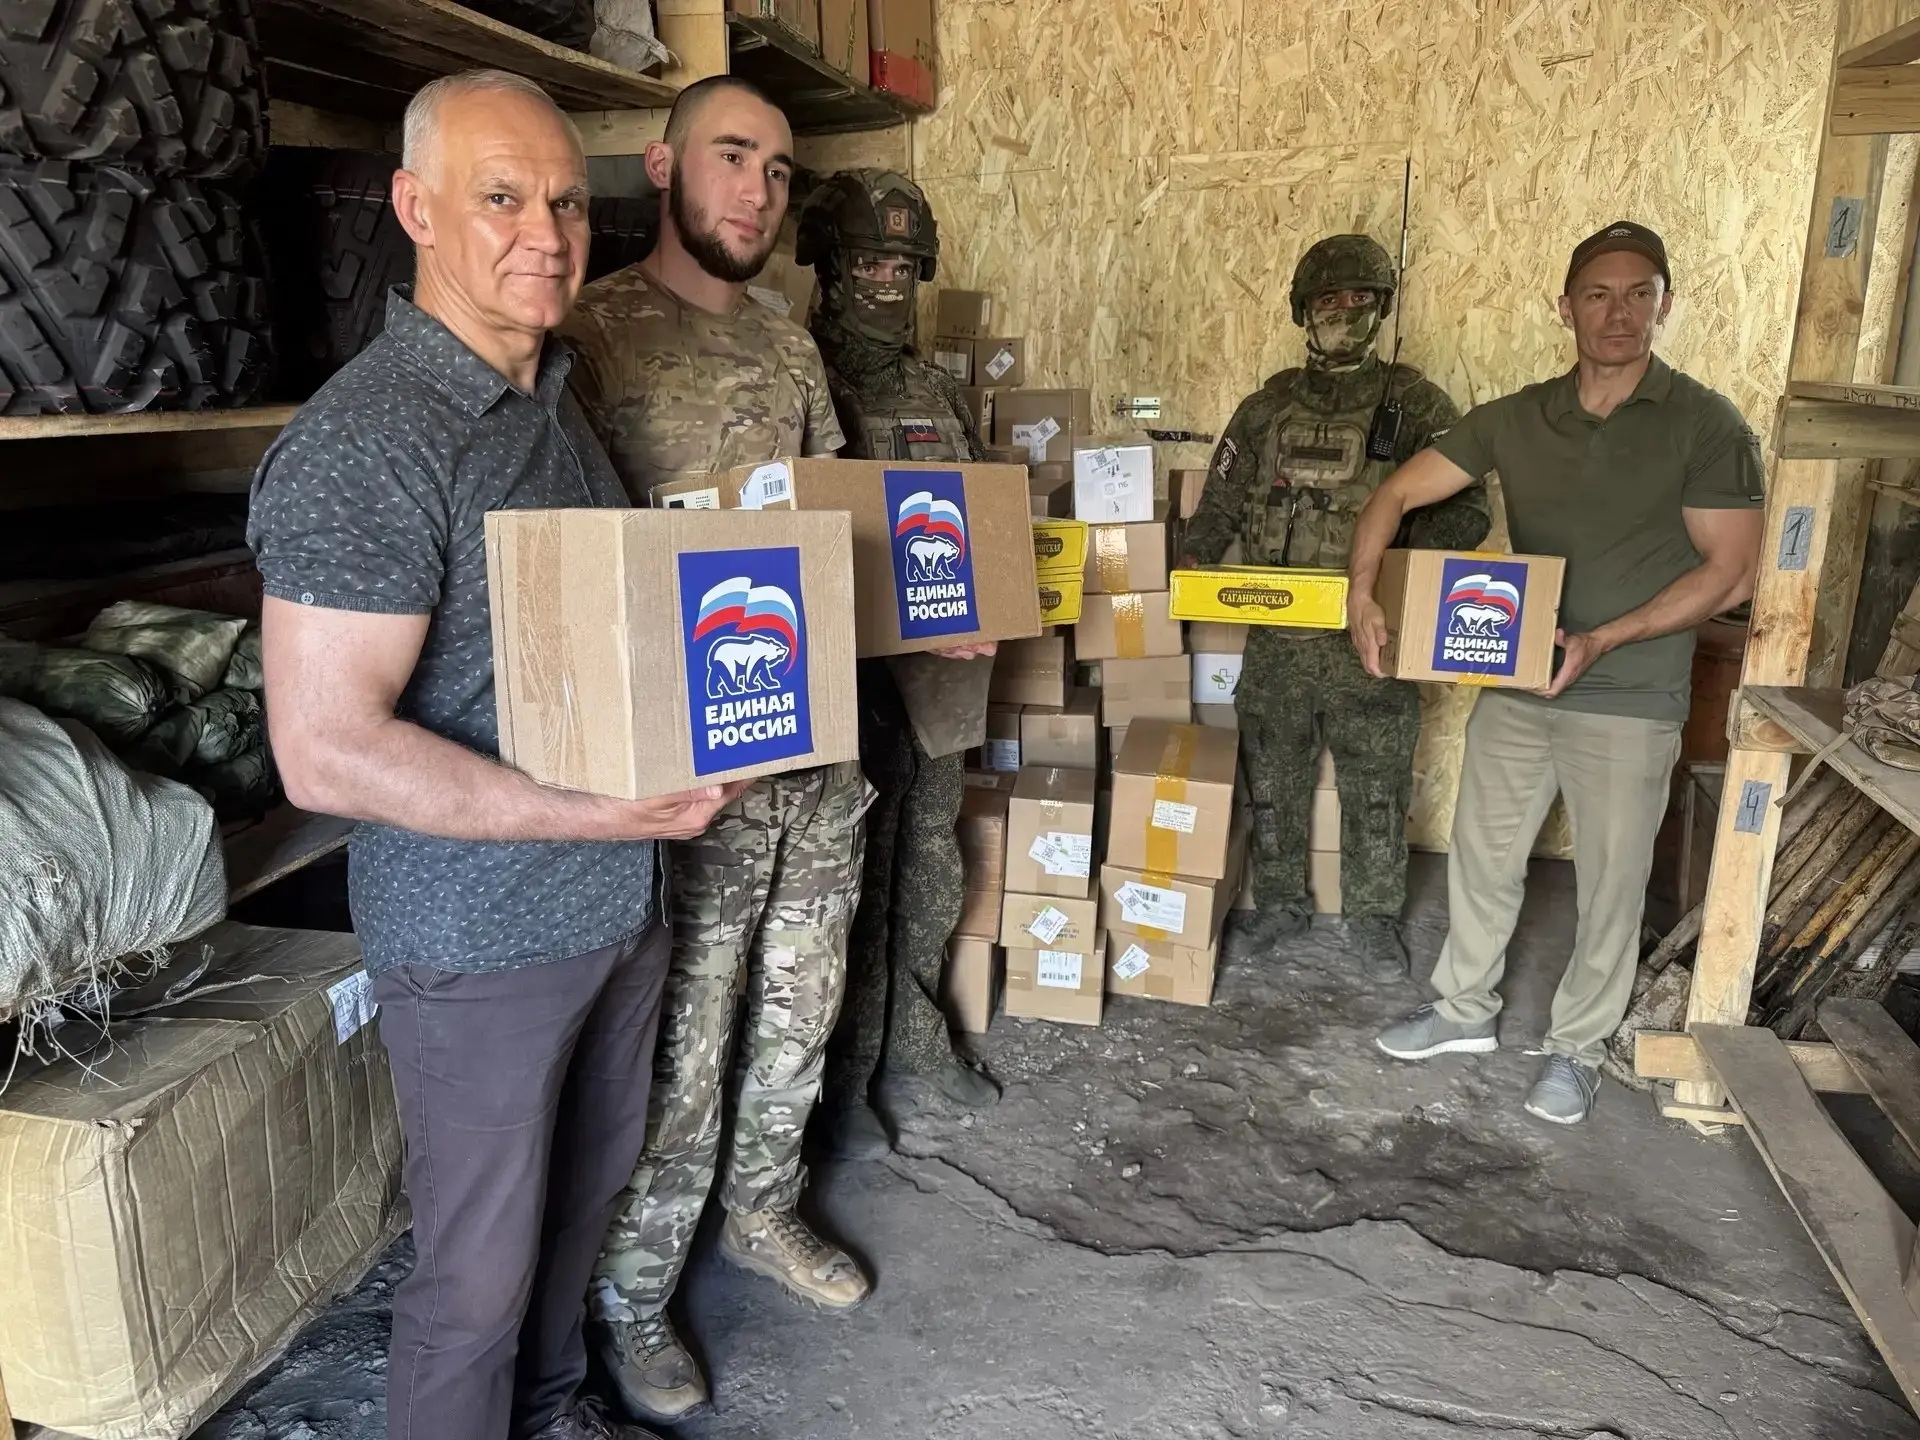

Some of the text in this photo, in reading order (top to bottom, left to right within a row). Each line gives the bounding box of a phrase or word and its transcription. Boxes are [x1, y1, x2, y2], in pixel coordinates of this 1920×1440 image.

[1893, 395, 1920, 408] ТРУ
[1785, 512, 1807, 556] 1
[1035, 543, 1061, 553] РОГСКАЯ
[906, 583, 966, 603] ЕДИНАЯ
[1220, 592, 1289, 605] ТАГАНРОГСКАЯ
[908, 600, 968, 621] РОССИЯ
[1444, 636, 1509, 651] ЕДИНАЯ
[1443, 648, 1507, 664] РОССИЯ
[704, 692, 795, 726] ЕДИНАЯ
[707, 714, 798, 750] РОССИЯ
[1746, 787, 1759, 826] 4
